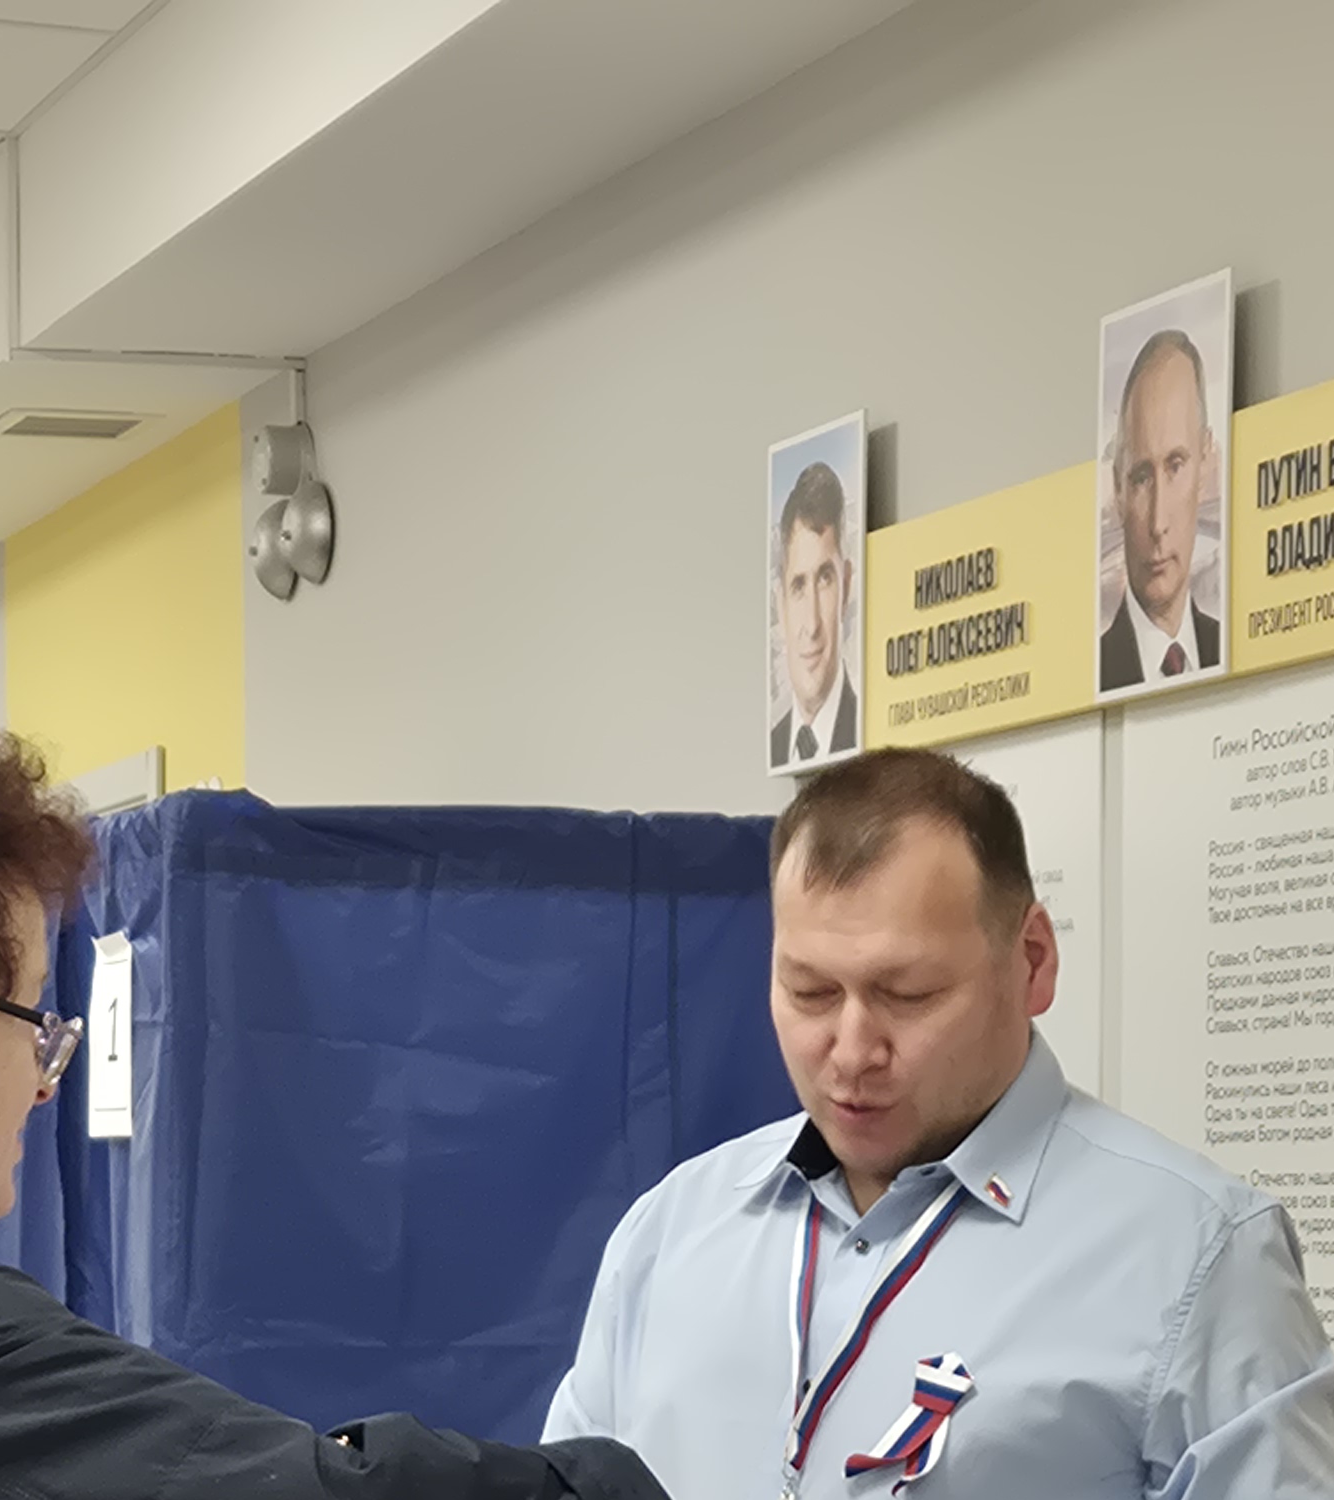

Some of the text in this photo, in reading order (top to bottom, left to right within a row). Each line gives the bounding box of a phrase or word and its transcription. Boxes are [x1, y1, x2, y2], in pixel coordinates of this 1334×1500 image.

[1257, 444, 1321, 508] ПУТИН
[915, 547, 997, 610] НИКОЛАЕВ
[887, 602, 1024, 677] ОЛЕГ АЛЕКСЕЕВИЧ
[1249, 598, 1312, 638] ПРЕЗИДЕНТ
[890, 672, 1030, 725] ГЛАВА ЧУВАШСКОЙ РЕСПУБЛИКИ
[108, 997, 119, 1062] 1
